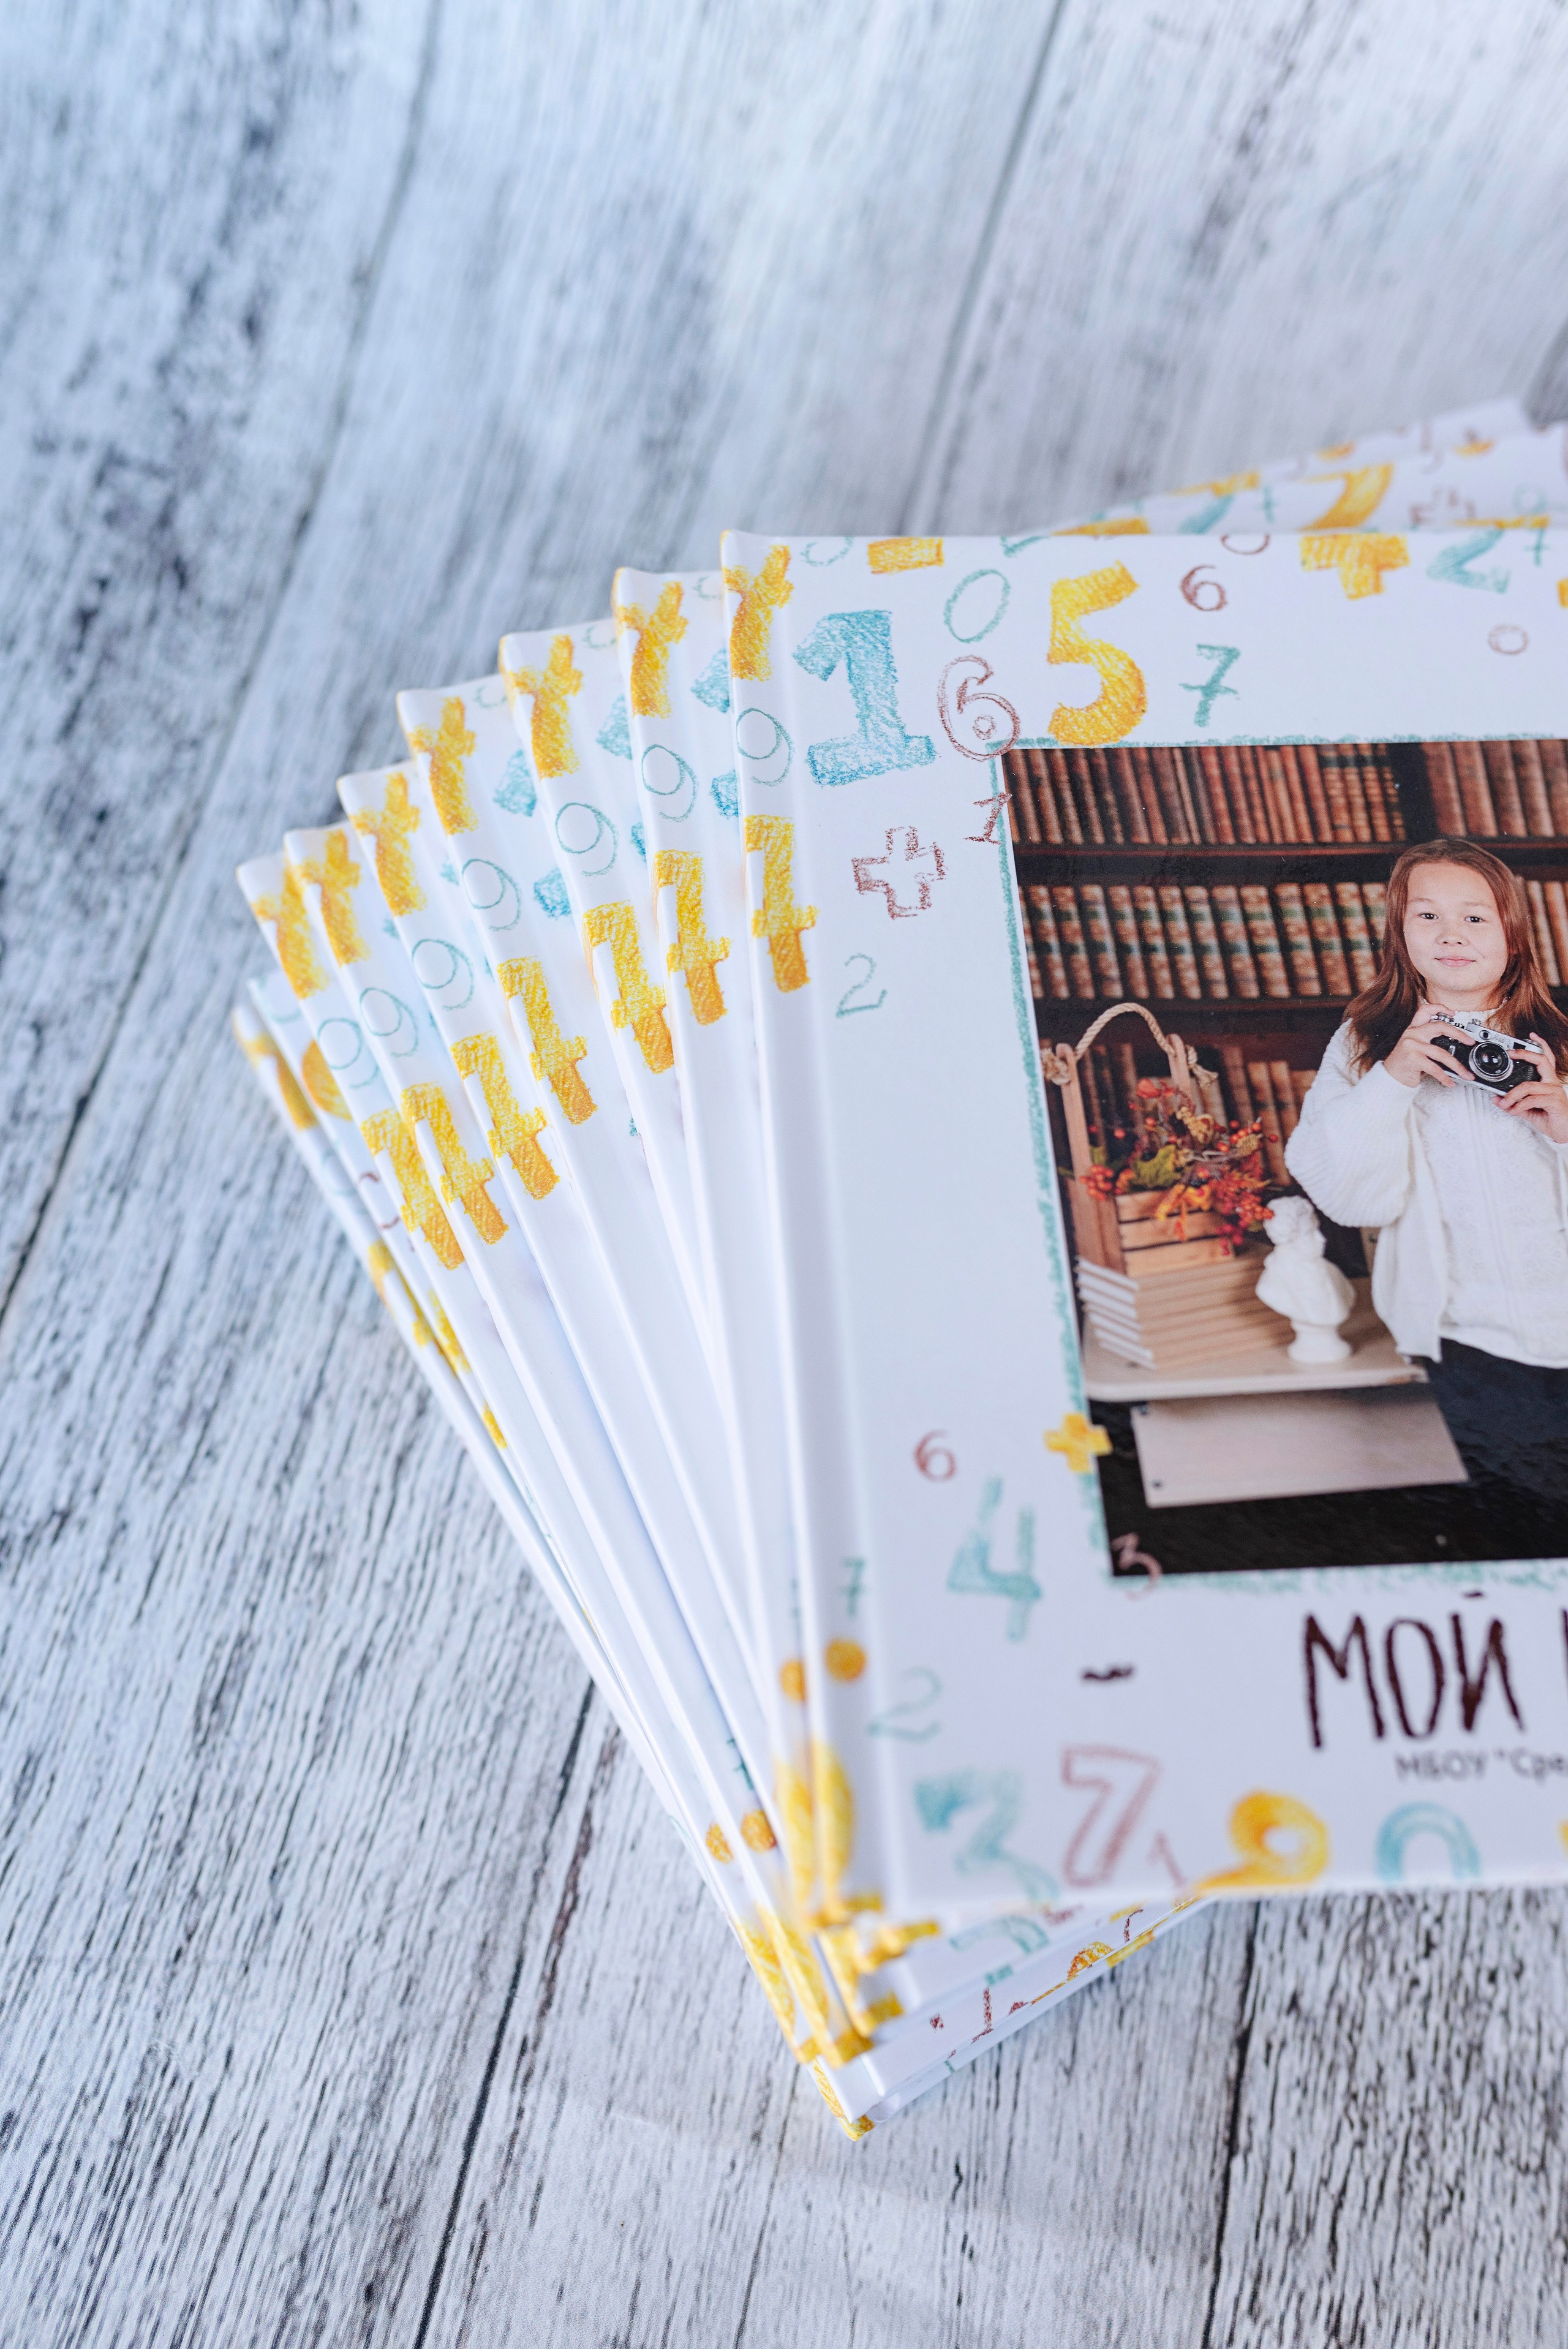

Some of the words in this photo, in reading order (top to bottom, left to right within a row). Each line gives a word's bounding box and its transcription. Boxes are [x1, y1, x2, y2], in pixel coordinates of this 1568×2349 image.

[944, 568, 1011, 643] 0
[1180, 565, 1227, 612] 6
[1046, 560, 1148, 747] 5
[1180, 643, 1241, 728] 7
[791, 609, 937, 788] 1
[937, 654, 1021, 763] 6
[640, 743, 698, 823] 9
[736, 707, 796, 787] 9
[554, 802, 619, 877] 9
[461, 858, 522, 931] 9
[411, 938, 473, 1011] 9
[835, 952, 888, 1018] 2
[359, 987, 418, 1058] 9
[912, 1428, 957, 1483] 6
[946, 1476, 1042, 1643] 4
[866, 1665, 943, 1743] 2
[1302, 1589, 1526, 1750] МОЙ
[1061, 1743, 1163, 1888] 7
